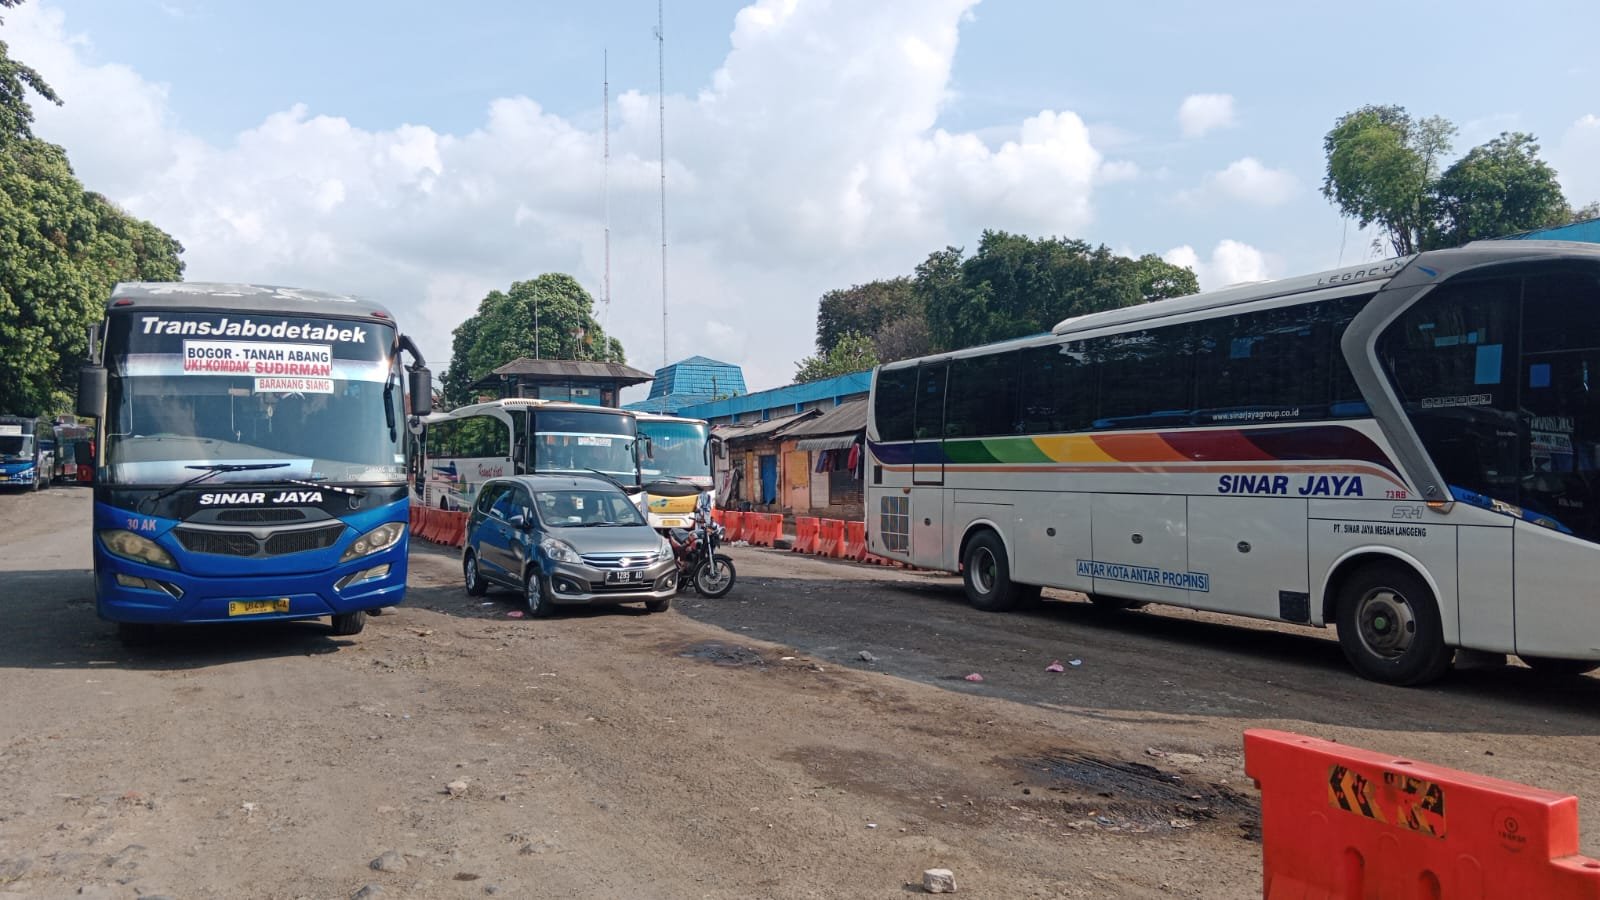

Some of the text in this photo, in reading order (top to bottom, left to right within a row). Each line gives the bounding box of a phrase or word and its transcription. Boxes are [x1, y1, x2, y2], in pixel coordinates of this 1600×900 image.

[1317, 264, 1393, 285] LEGACY
[141, 316, 367, 343] TransJabodetabek
[187, 347, 232, 360] BOGOR
[242, 349, 284, 361] TANAH
[288, 350, 329, 363] ABANG
[184, 359, 331, 377] UKI-KOMDAK SUDIRMAN
[259, 378, 330, 392] BARANANG SIANG
[1212, 408, 1299, 420] www.sinarjayagroup.co.id
[1217, 475, 1364, 496] SINAR JAYA
[200, 492, 323, 505] SINAR JAYA
[127, 518, 157, 531] 30 AK
[1344, 524, 1360, 534] SINAR
[1361, 525, 1374, 535] JAYA
[1395, 526, 1427, 537] LANGGENG
[1079, 562, 1208, 590] ANTAR KOTA ANTAR PROPINSI
